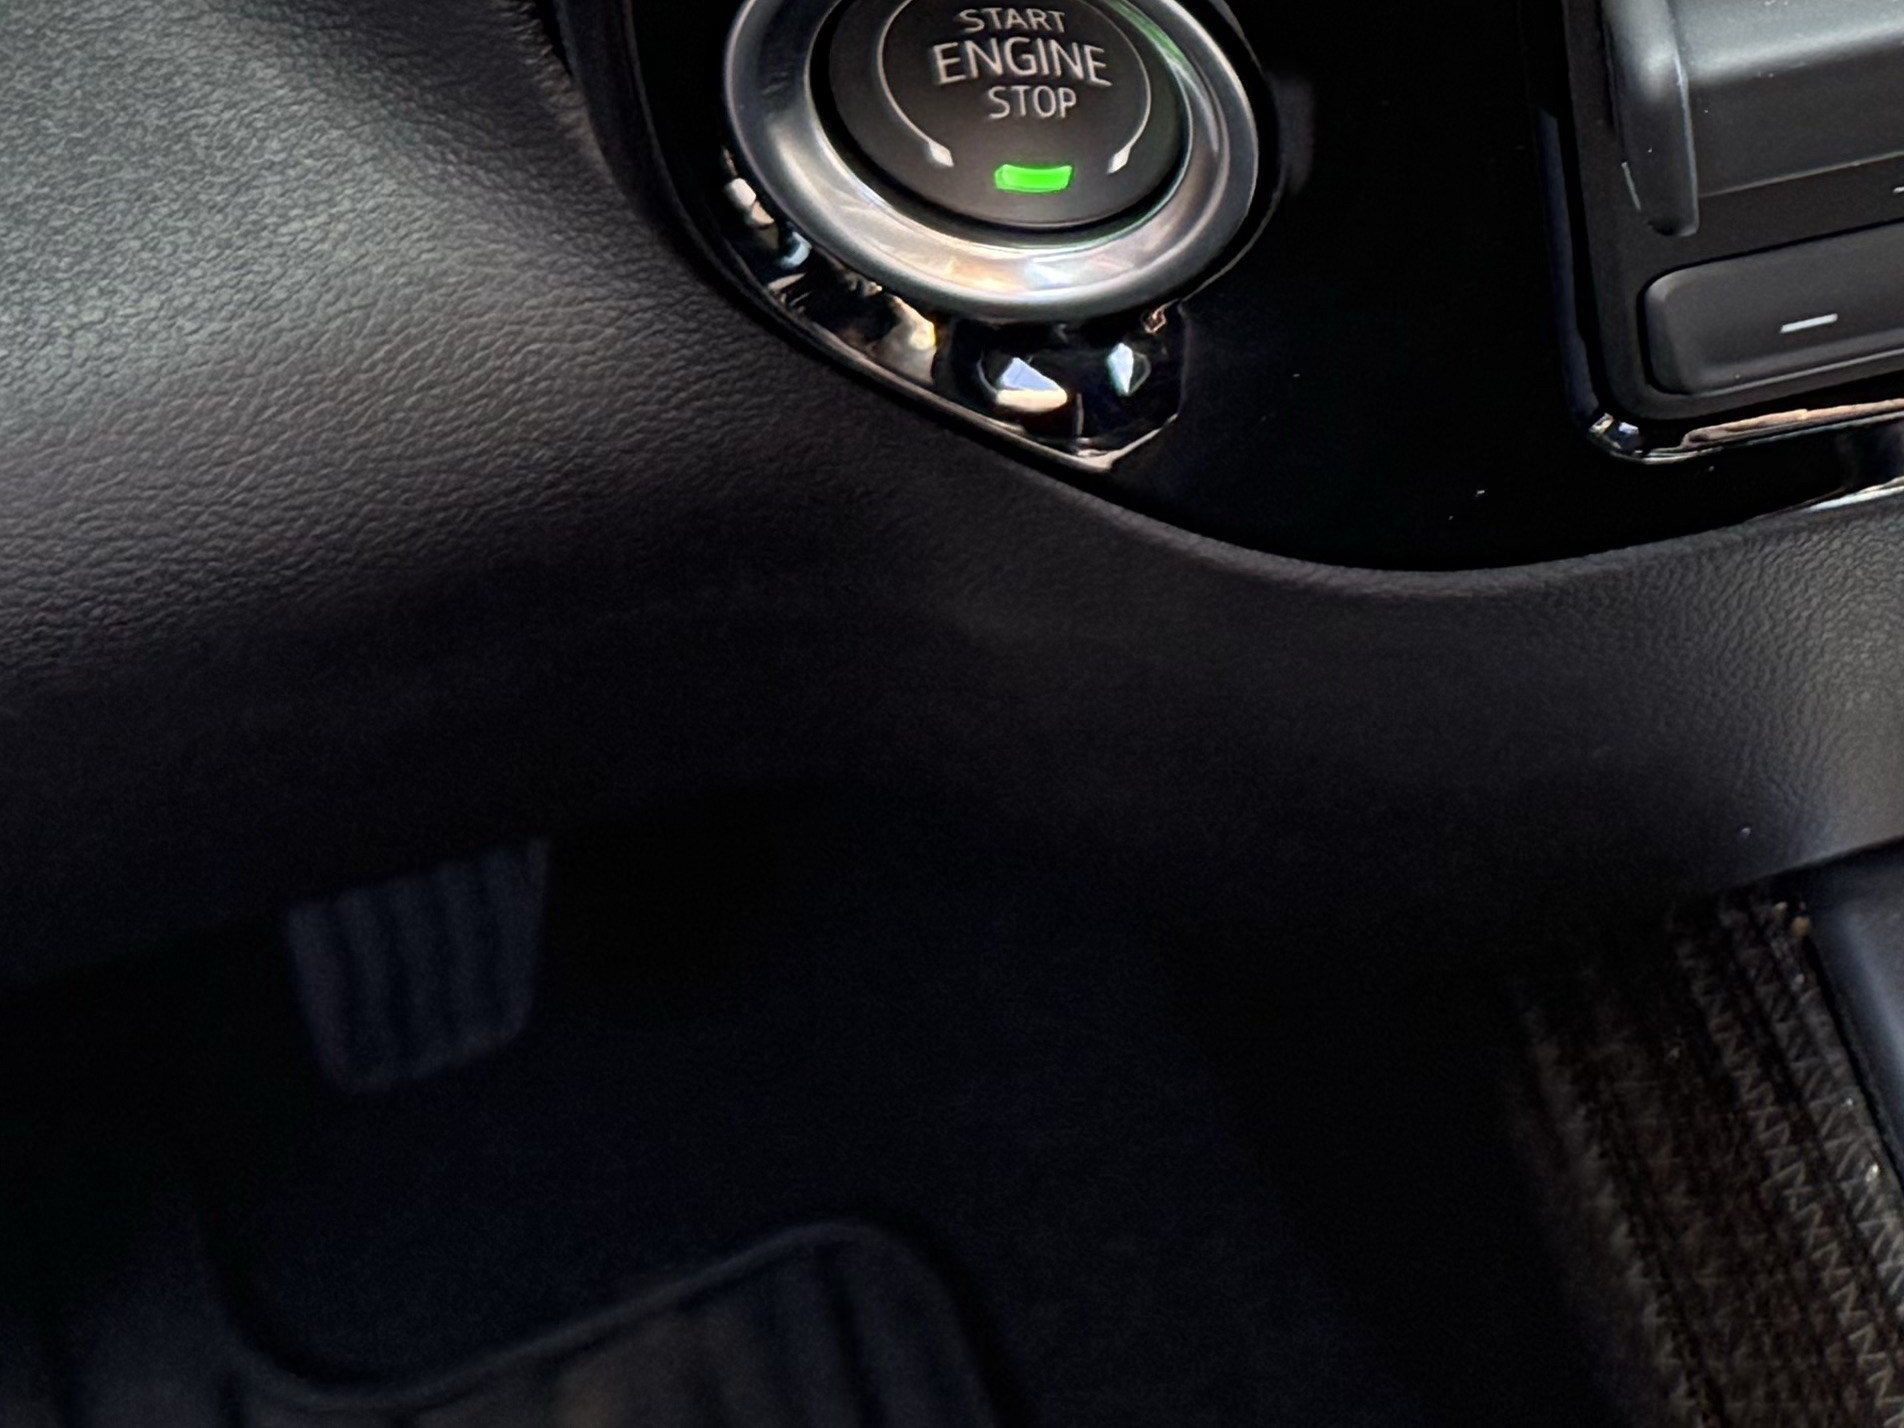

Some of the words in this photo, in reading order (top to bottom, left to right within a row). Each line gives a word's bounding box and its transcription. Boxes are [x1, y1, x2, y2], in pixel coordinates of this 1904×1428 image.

[959, 8, 1064, 32] START
[933, 36, 1112, 87] ENGINE
[988, 86, 1076, 119] STOP
